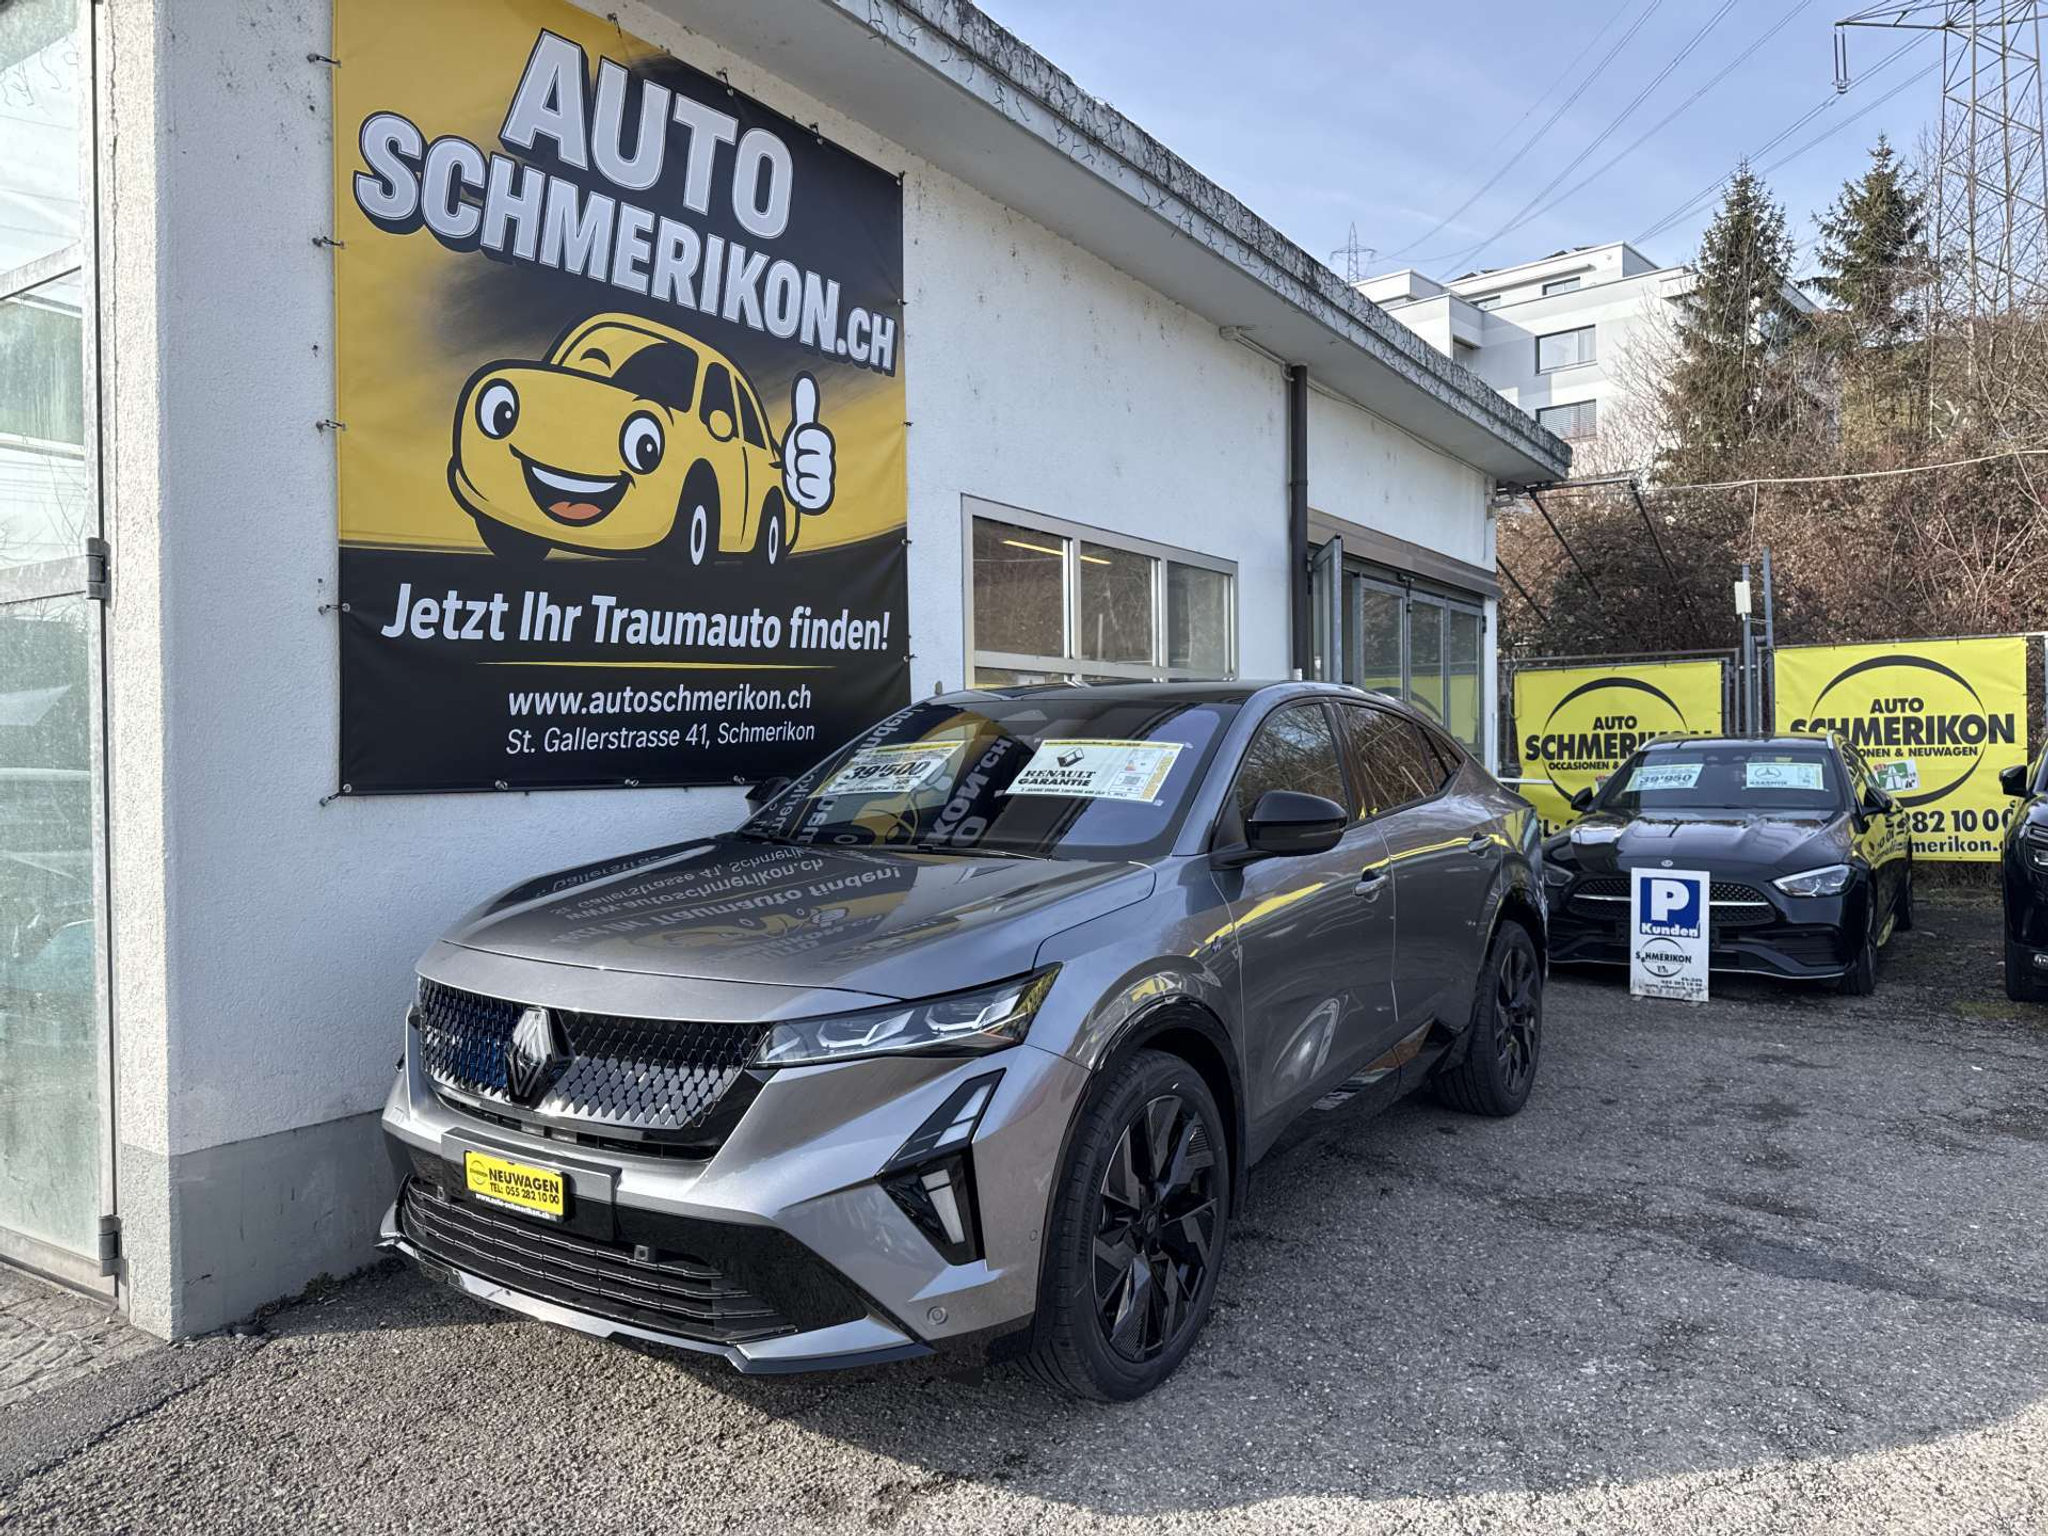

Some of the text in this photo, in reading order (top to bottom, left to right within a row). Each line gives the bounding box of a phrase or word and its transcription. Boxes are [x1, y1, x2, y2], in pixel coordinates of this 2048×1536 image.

[501, 30, 793, 240] AUTO
[355, 113, 895, 371] SCHMERIKON.CH
[381, 583, 890, 650] Jetzt Ihr Traumauto finden!
[508, 684, 811, 716] www.autoschmerikon.ch
[1870, 697, 1924, 714] AUTO
[1592, 716, 1638, 731] AUTO
[506, 721, 815, 755] St. Gallerstrasse 41, Schmerikon
[1525, 731, 1712, 761] SCHMERI
[1909, 747, 1978, 757] NEUWAGEN
[846, 761, 932, 779] 39'500
[1024, 769, 1096, 779] RENAULT
[1549, 762, 1609, 770] OCCASIONEN
[1018, 778, 1092, 787] GARANTIE
[1906, 811, 1945, 833] 82
[1951, 810, 1978, 832] 10
[1651, 879, 1690, 921] P
[1641, 922, 1698, 937] Kunden
[489, 1168, 560, 1194] NEUWAGEN
[490, 1182, 560, 1204] TEL: 055 282 10 00
